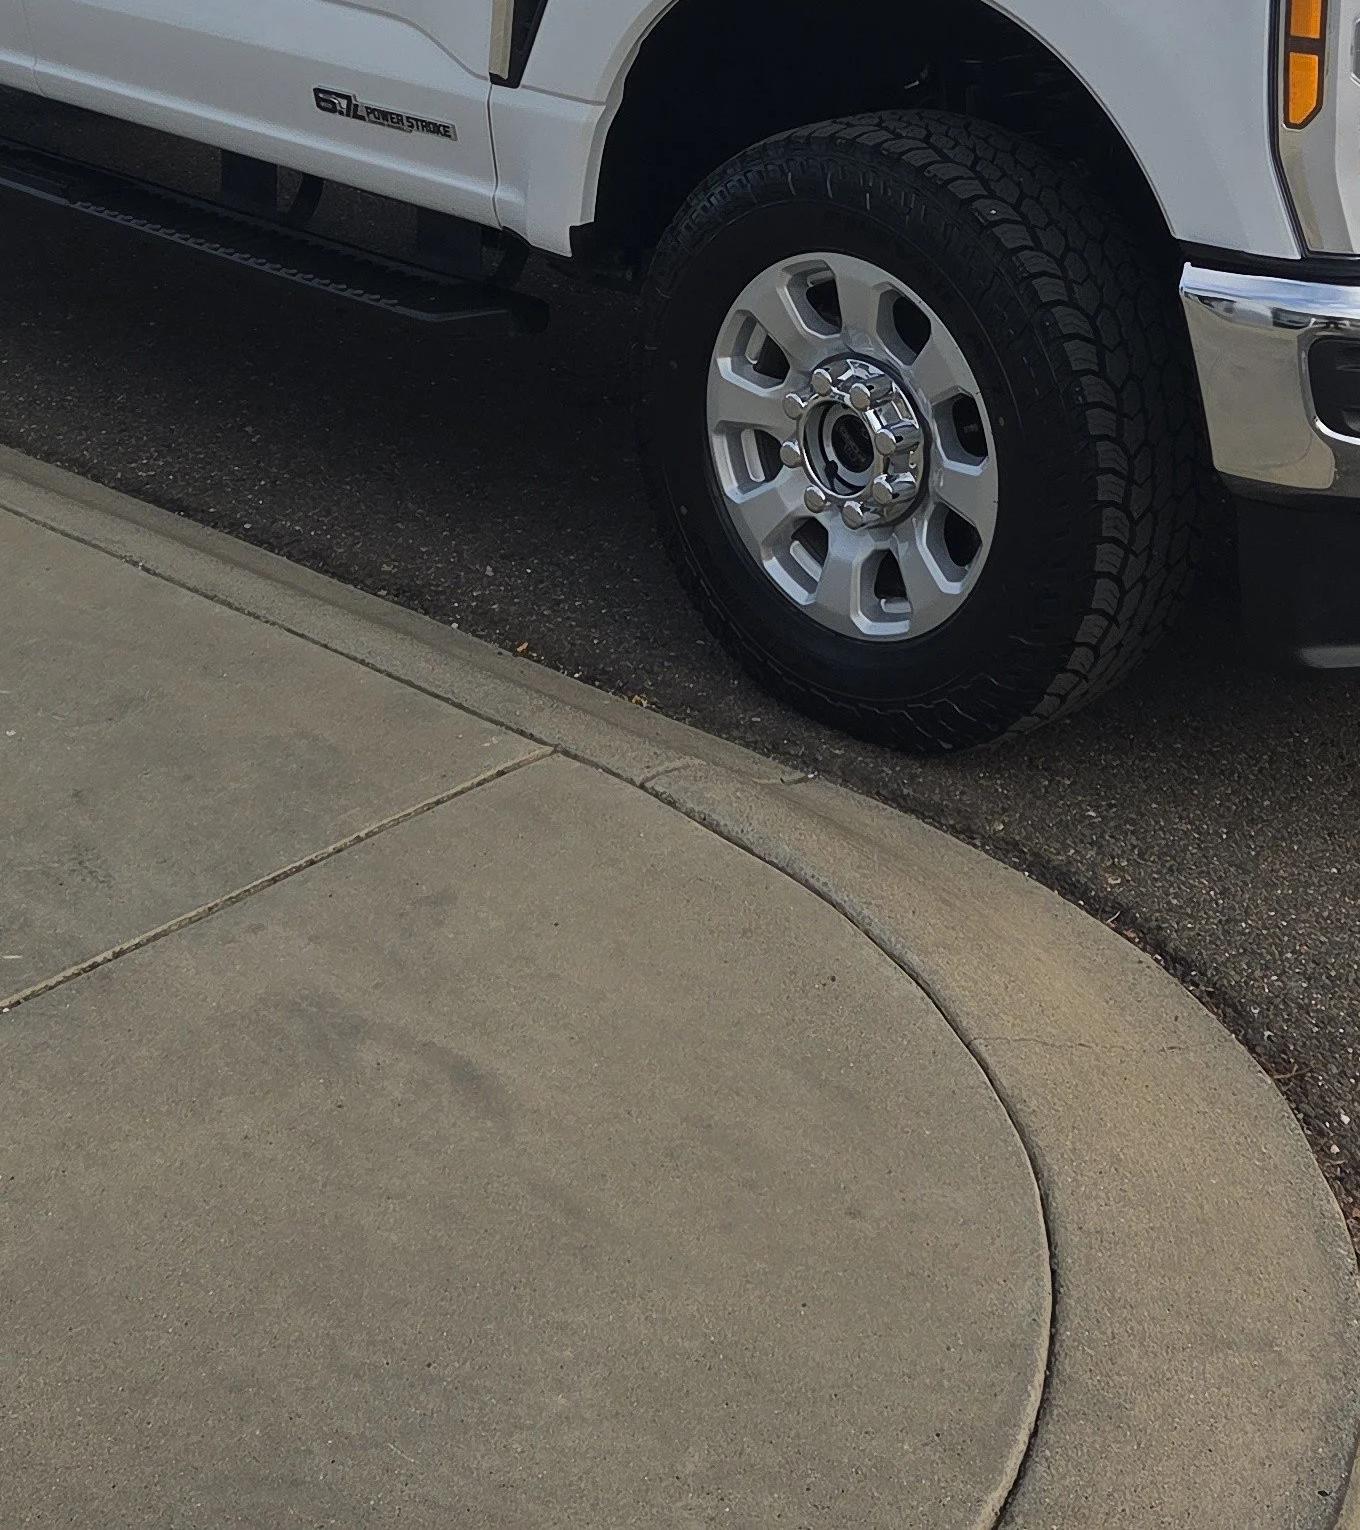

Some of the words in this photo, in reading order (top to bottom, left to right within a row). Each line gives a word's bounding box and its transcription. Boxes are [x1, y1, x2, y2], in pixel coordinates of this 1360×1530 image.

[313, 88, 366, 122] 6.7L
[365, 106, 405, 127] POWER
[405, 115, 452, 139] STROKE
